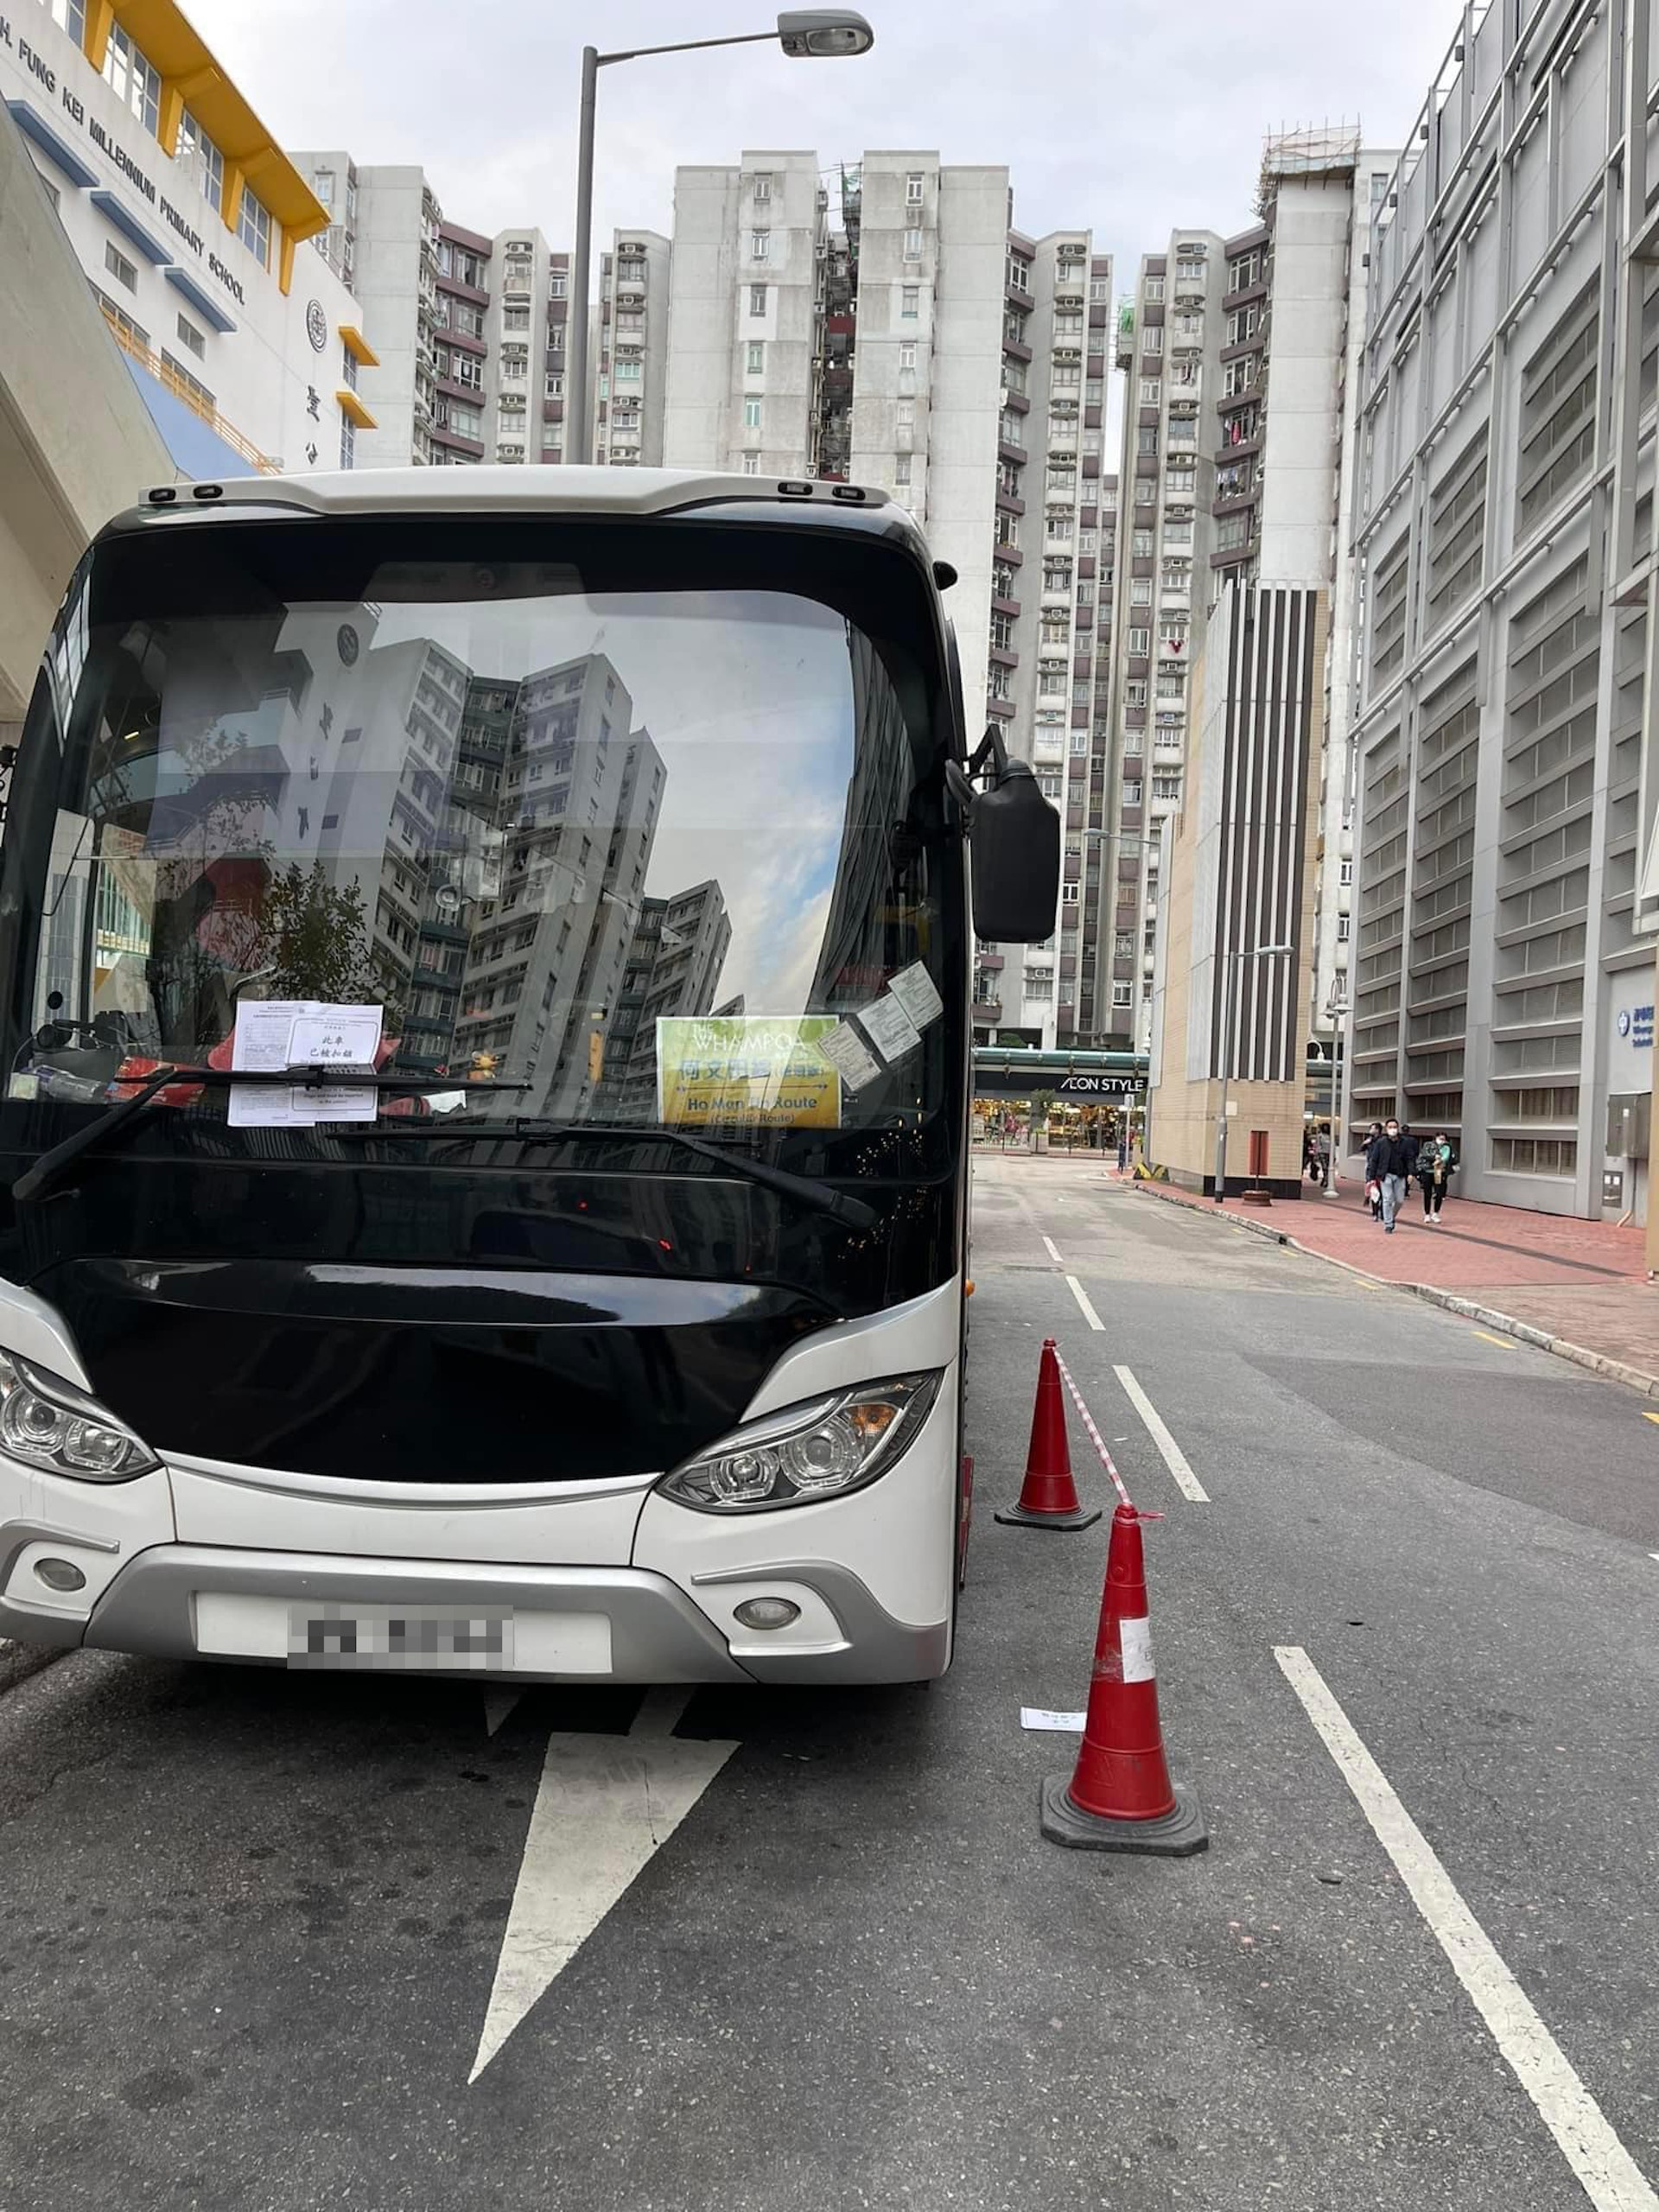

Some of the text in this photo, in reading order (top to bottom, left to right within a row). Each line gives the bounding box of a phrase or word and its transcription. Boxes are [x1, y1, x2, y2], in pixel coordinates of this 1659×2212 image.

[19, 38, 55, 93] FUNG
[63, 86, 84, 125] KEI
[90, 117, 156, 204] MILLENNIUM
[160, 195, 204, 257] PRIMARY
[209, 252, 245, 305] SCHOOL
[692, 1033, 807, 1052] WHAMPOA
[1101, 1077, 1145, 1092] STYLE
[688, 1097, 709, 1110] Ho
[774, 1096, 817, 1109] Route
